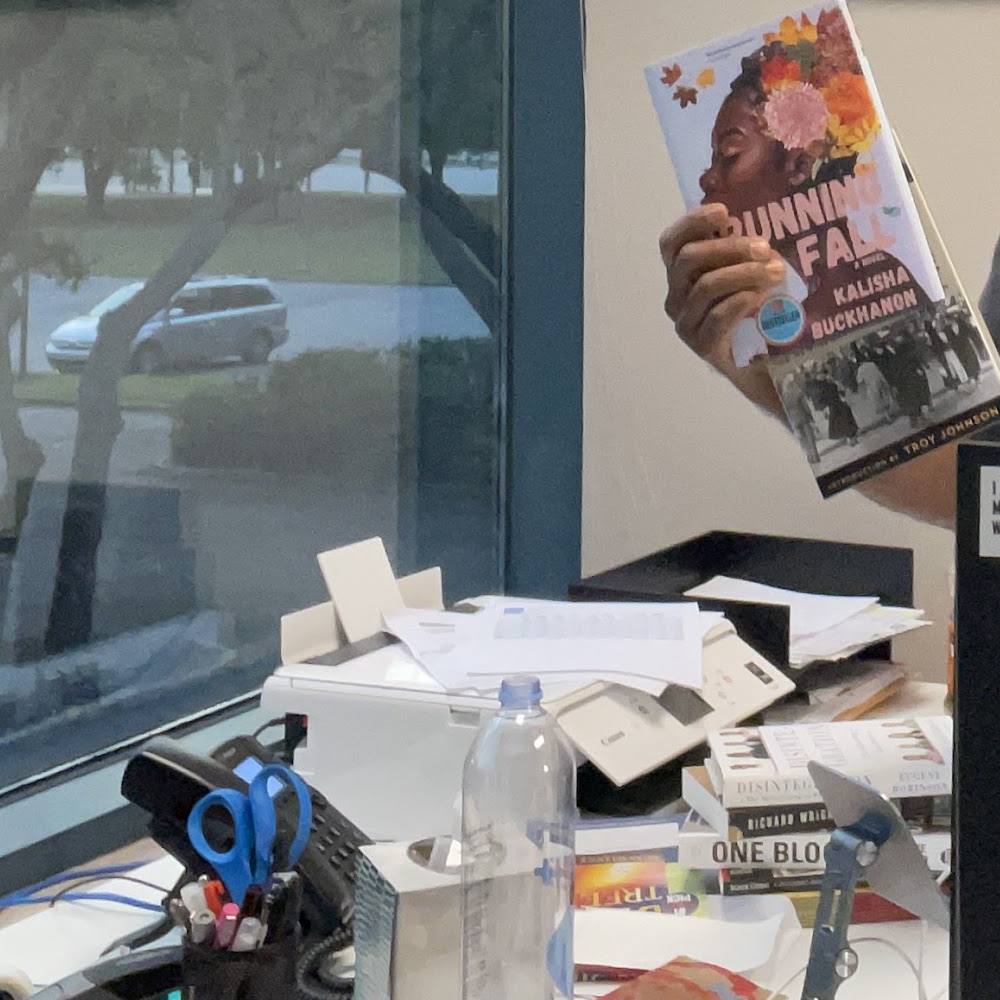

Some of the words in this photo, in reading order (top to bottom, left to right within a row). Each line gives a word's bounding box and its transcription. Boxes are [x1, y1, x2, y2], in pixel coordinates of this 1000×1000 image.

[833, 266, 910, 306] KALISHA
[810, 288, 918, 340] BUCKHANON
[903, 434, 936, 455] TROY
[941, 406, 1000, 441] JOHNSON
[748, 813, 794, 831] RICHARD
[712, 841, 764, 863] ONE
[774, 841, 821, 863] BLO
